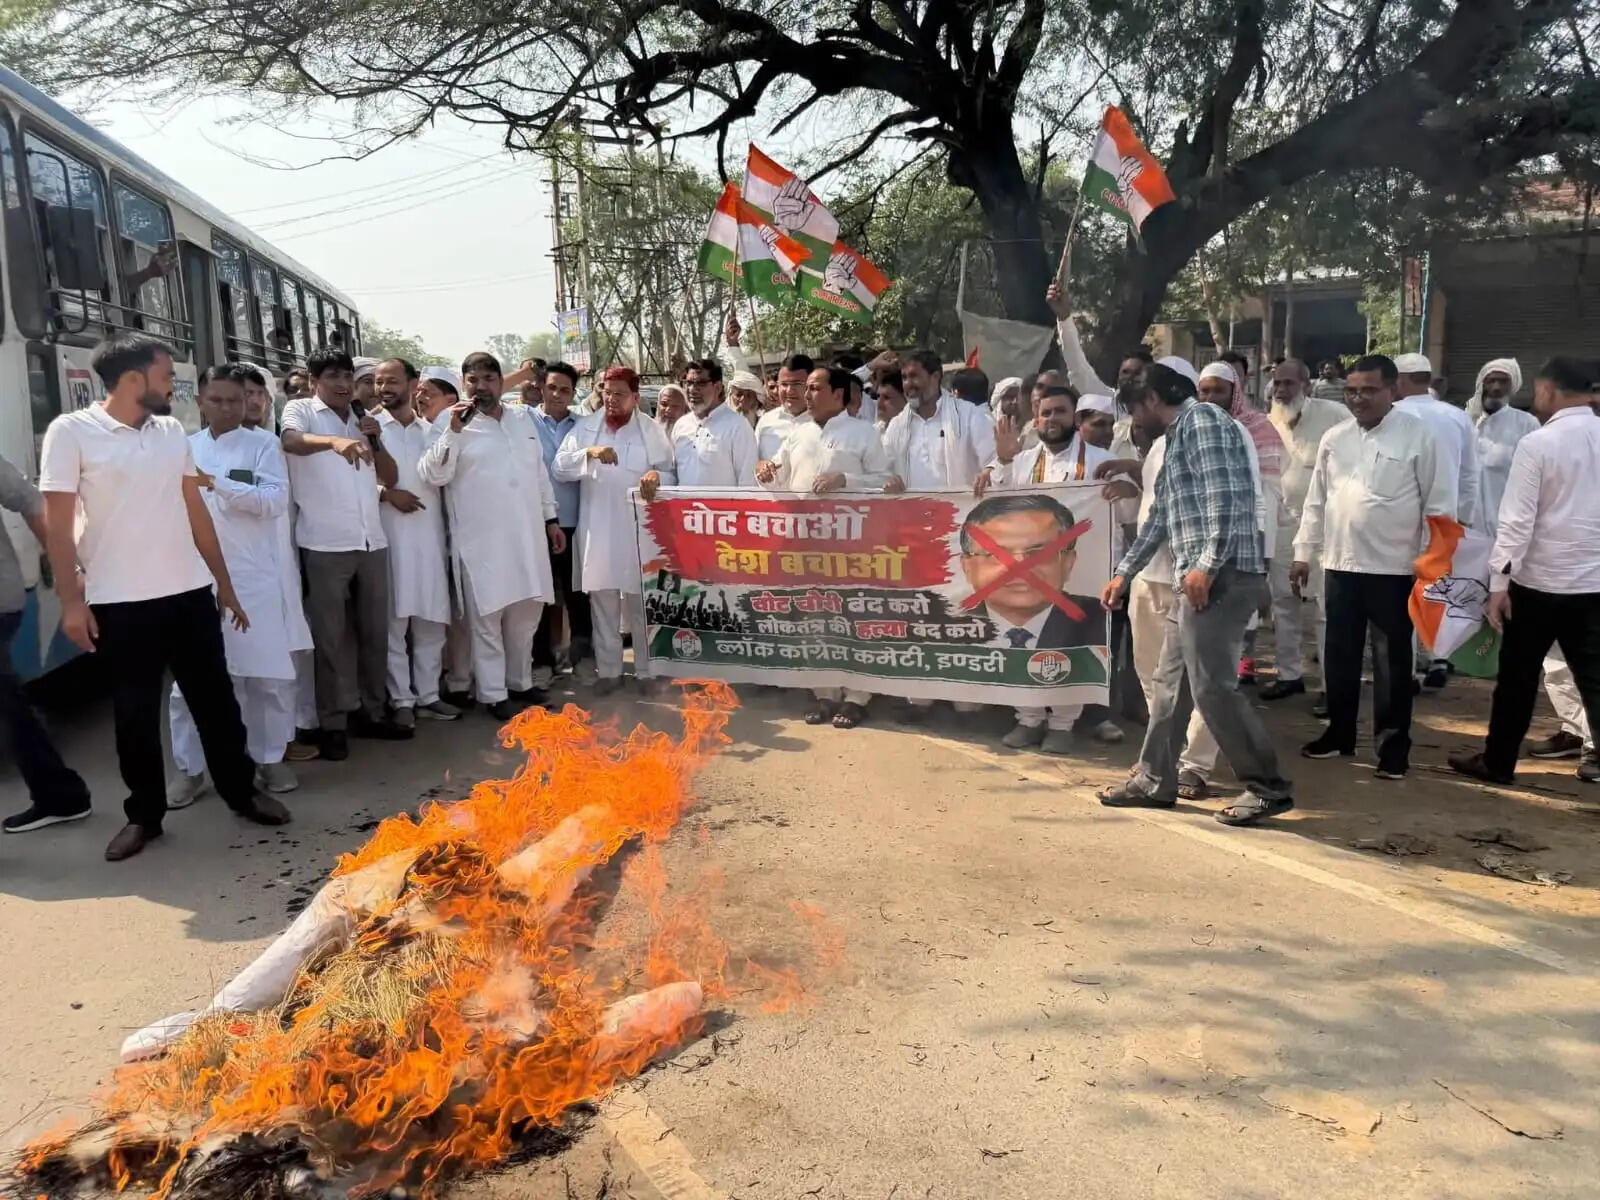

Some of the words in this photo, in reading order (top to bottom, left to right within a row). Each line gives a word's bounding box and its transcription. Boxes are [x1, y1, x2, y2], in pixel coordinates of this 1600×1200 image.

[681, 502, 738, 536] वोट
[745, 505, 871, 540] बचाओं
[715, 540, 771, 575] देश
[778, 545, 908, 581] बचाओं
[751, 591, 791, 614] वोट
[794, 590, 842, 614] चोरी
[847, 592, 884, 614] बंद
[888, 593, 930, 615] करो
[755, 614, 826, 635] लोकतंत्र
[827, 615, 852, 636] की
[854, 620, 908, 639] हत्या
[944, 618, 986, 639] करो
[715, 636, 775, 658] ब्लॉक
[777, 639, 849, 661] कांग्रेस
[850, 642, 931, 672] कमेटी,
[935, 651, 1007, 673] इण्डरी
